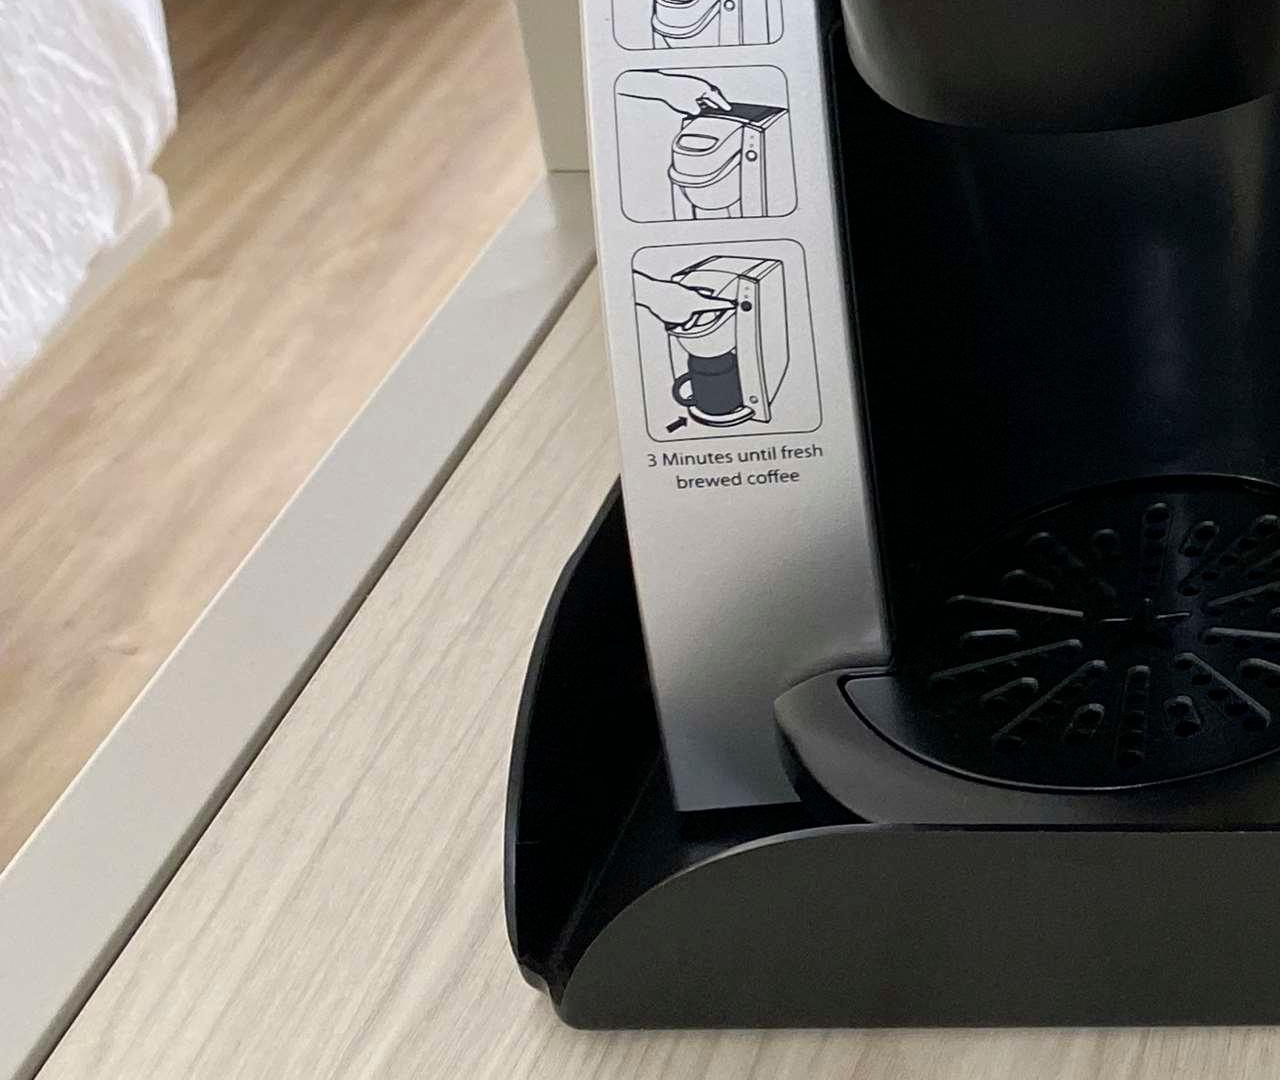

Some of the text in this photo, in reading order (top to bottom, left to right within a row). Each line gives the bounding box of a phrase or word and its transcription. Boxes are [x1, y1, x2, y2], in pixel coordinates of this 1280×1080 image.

[647, 444, 823, 467] 3 Minutes until fresh
[676, 469, 800, 489] brewed coffee
